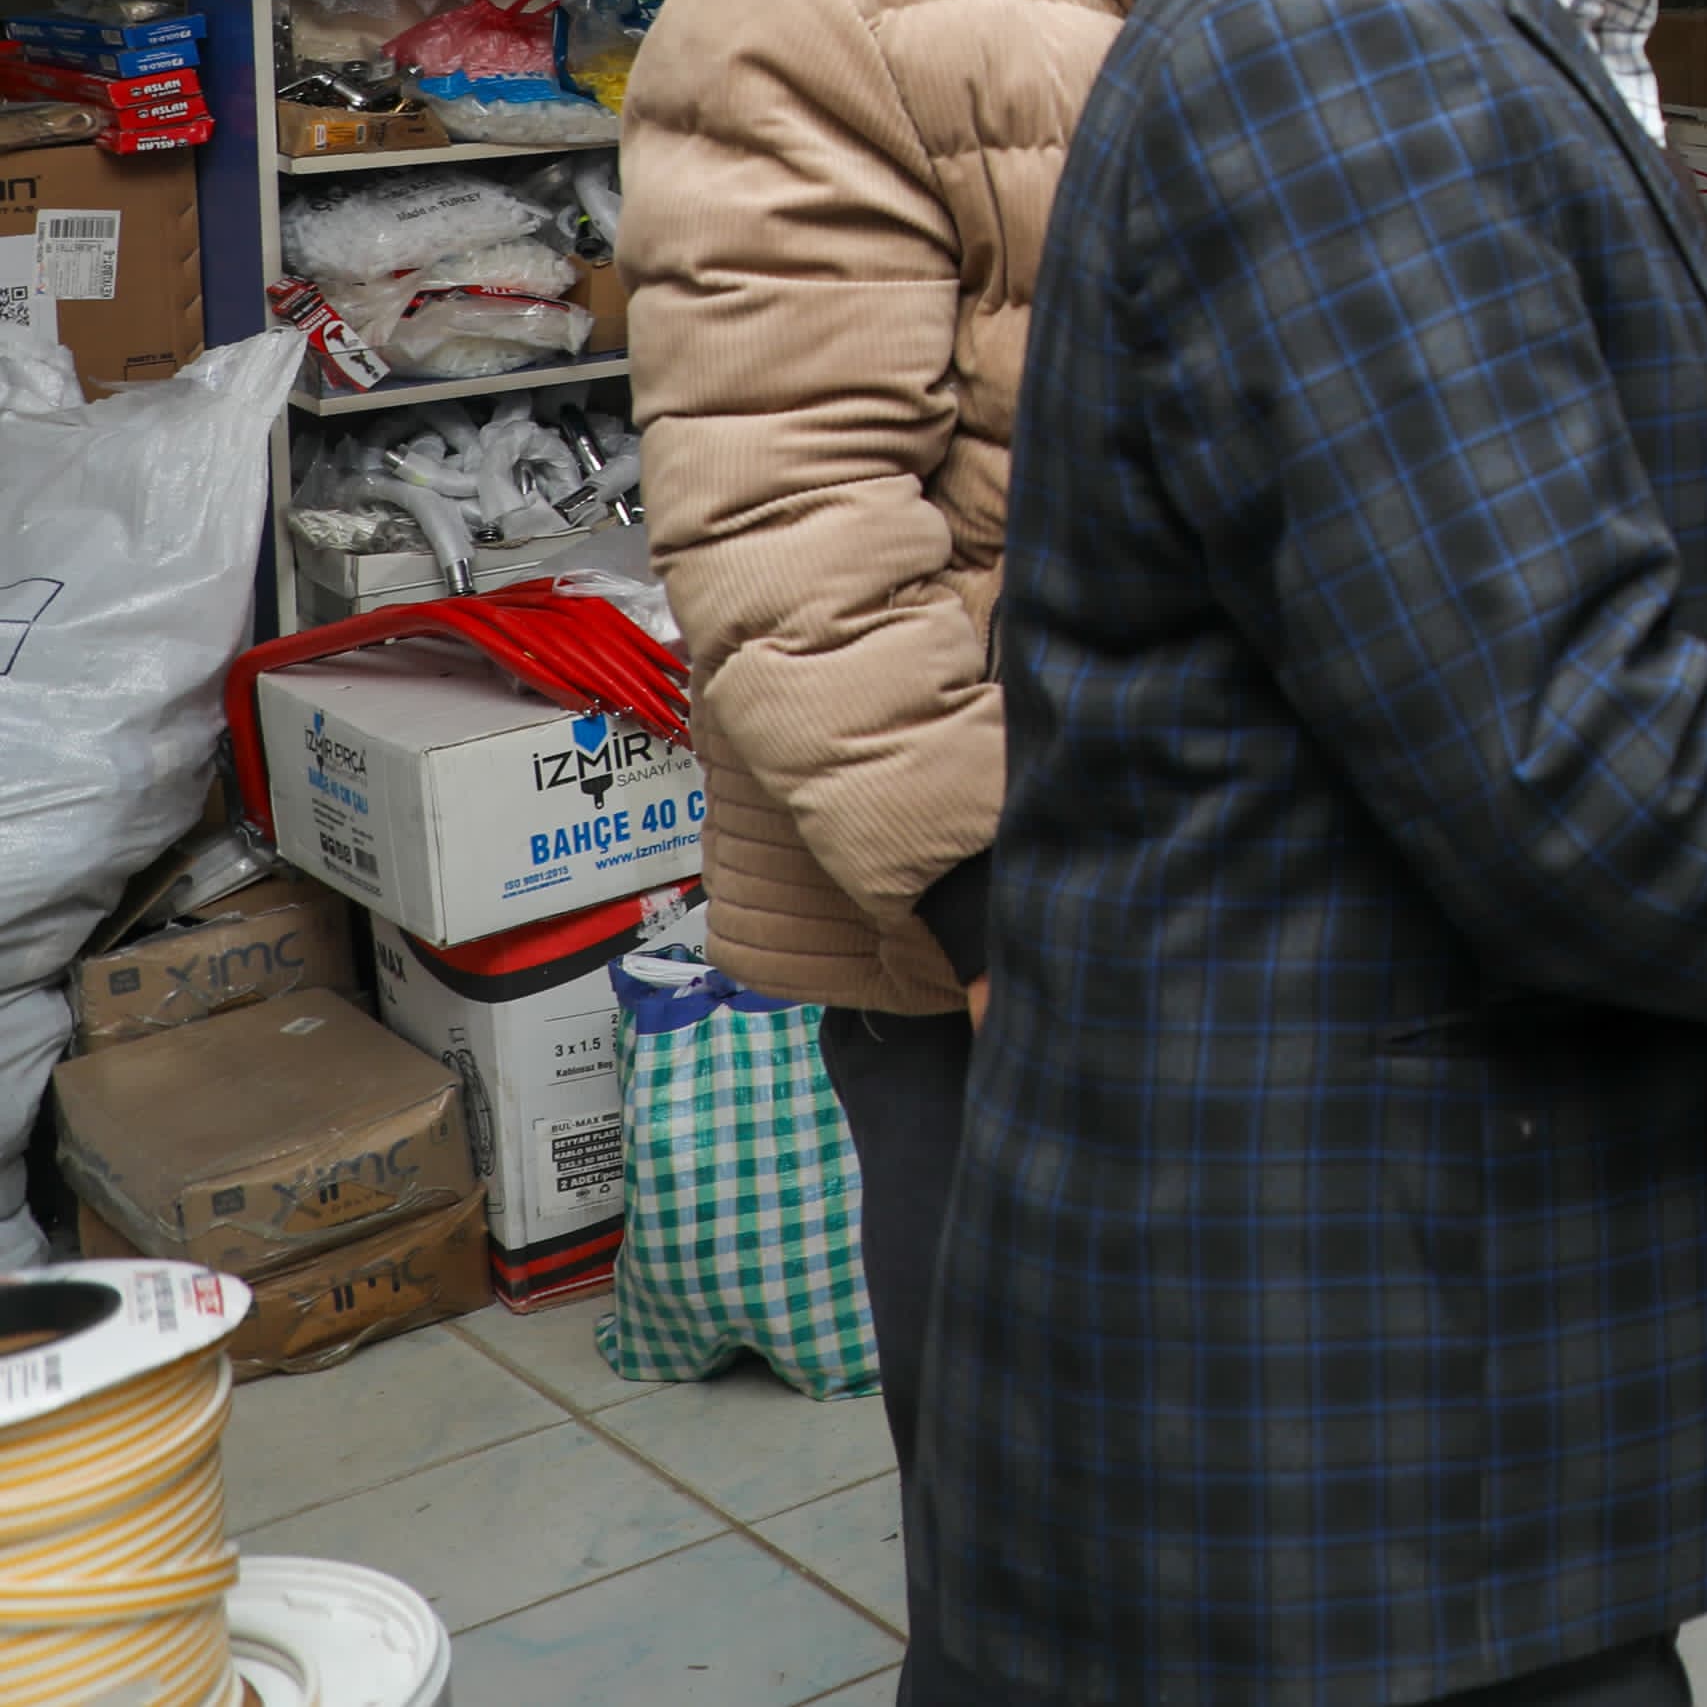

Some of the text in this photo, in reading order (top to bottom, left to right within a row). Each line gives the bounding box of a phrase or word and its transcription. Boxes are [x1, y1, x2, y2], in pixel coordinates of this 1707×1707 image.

[144, 79, 181, 94] ASLAN
[151, 101, 188, 116] ASLAN
[137, 139, 176, 151] ASLAN
[438, 192, 482, 210] TURKEY
[530, 810, 631, 867] BAHÇE
[642, 797, 676, 834] 40
[555, 1044, 564, 1058] 3
[580, 1037, 601, 1053] 1.5
[551, 1116, 600, 1134] BUL-MAX
[560, 1178, 568, 1191] 2
